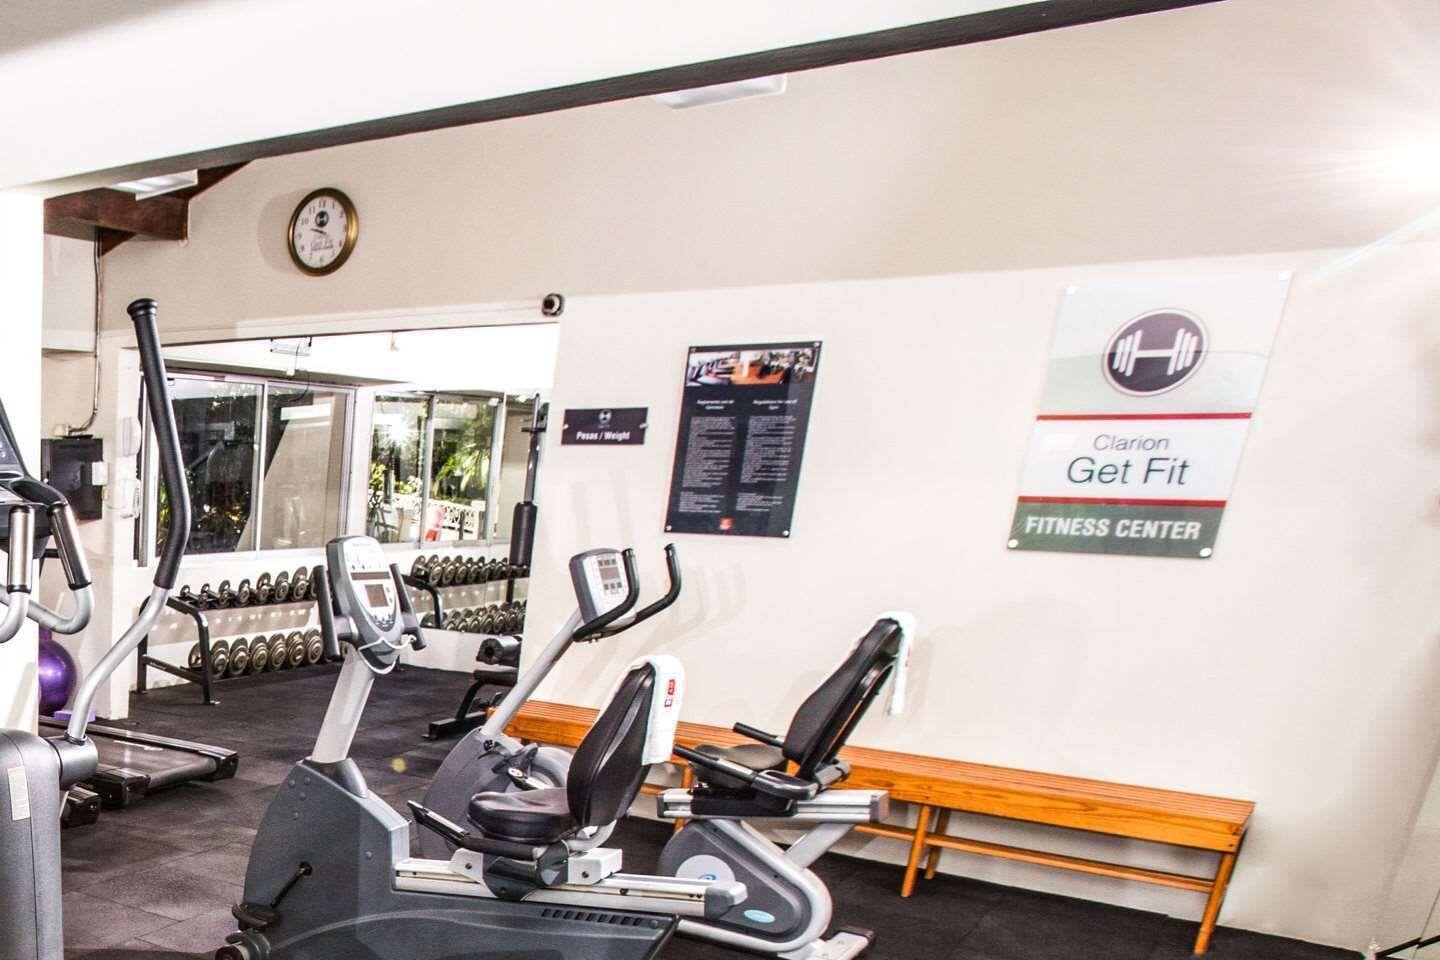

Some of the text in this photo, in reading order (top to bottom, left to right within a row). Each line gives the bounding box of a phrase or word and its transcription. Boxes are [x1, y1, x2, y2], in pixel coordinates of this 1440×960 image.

[576, 431, 598, 440] Pesas
[604, 431, 631, 442] Weight
[1093, 434, 1170, 451] Clarion
[1067, 456, 1190, 485] Get Fit
[1025, 516, 1202, 540] FITNESS CENTER
